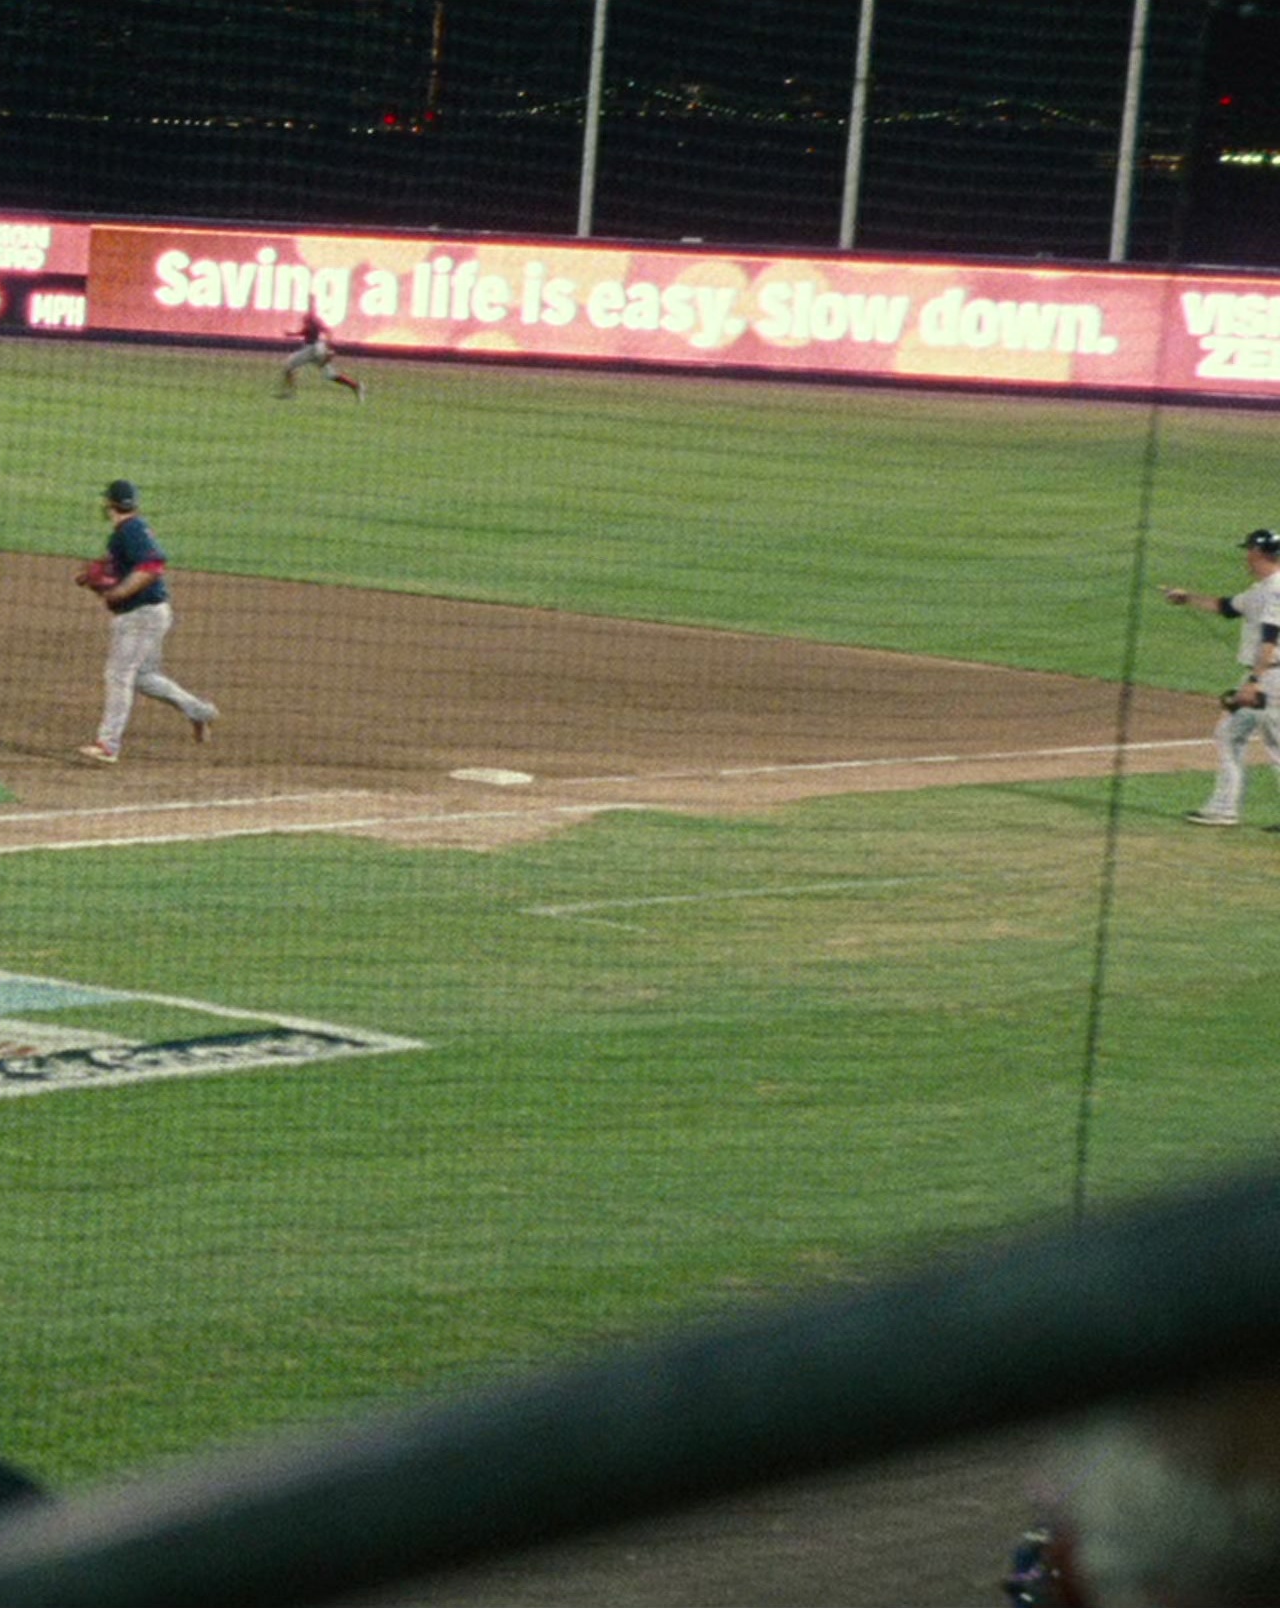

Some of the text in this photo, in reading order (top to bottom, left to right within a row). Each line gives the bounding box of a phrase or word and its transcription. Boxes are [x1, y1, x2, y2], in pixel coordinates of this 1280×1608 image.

[31, 293, 87, 326] MPH
[154, 246, 1120, 355] Saving a life is easy. Slow down.
